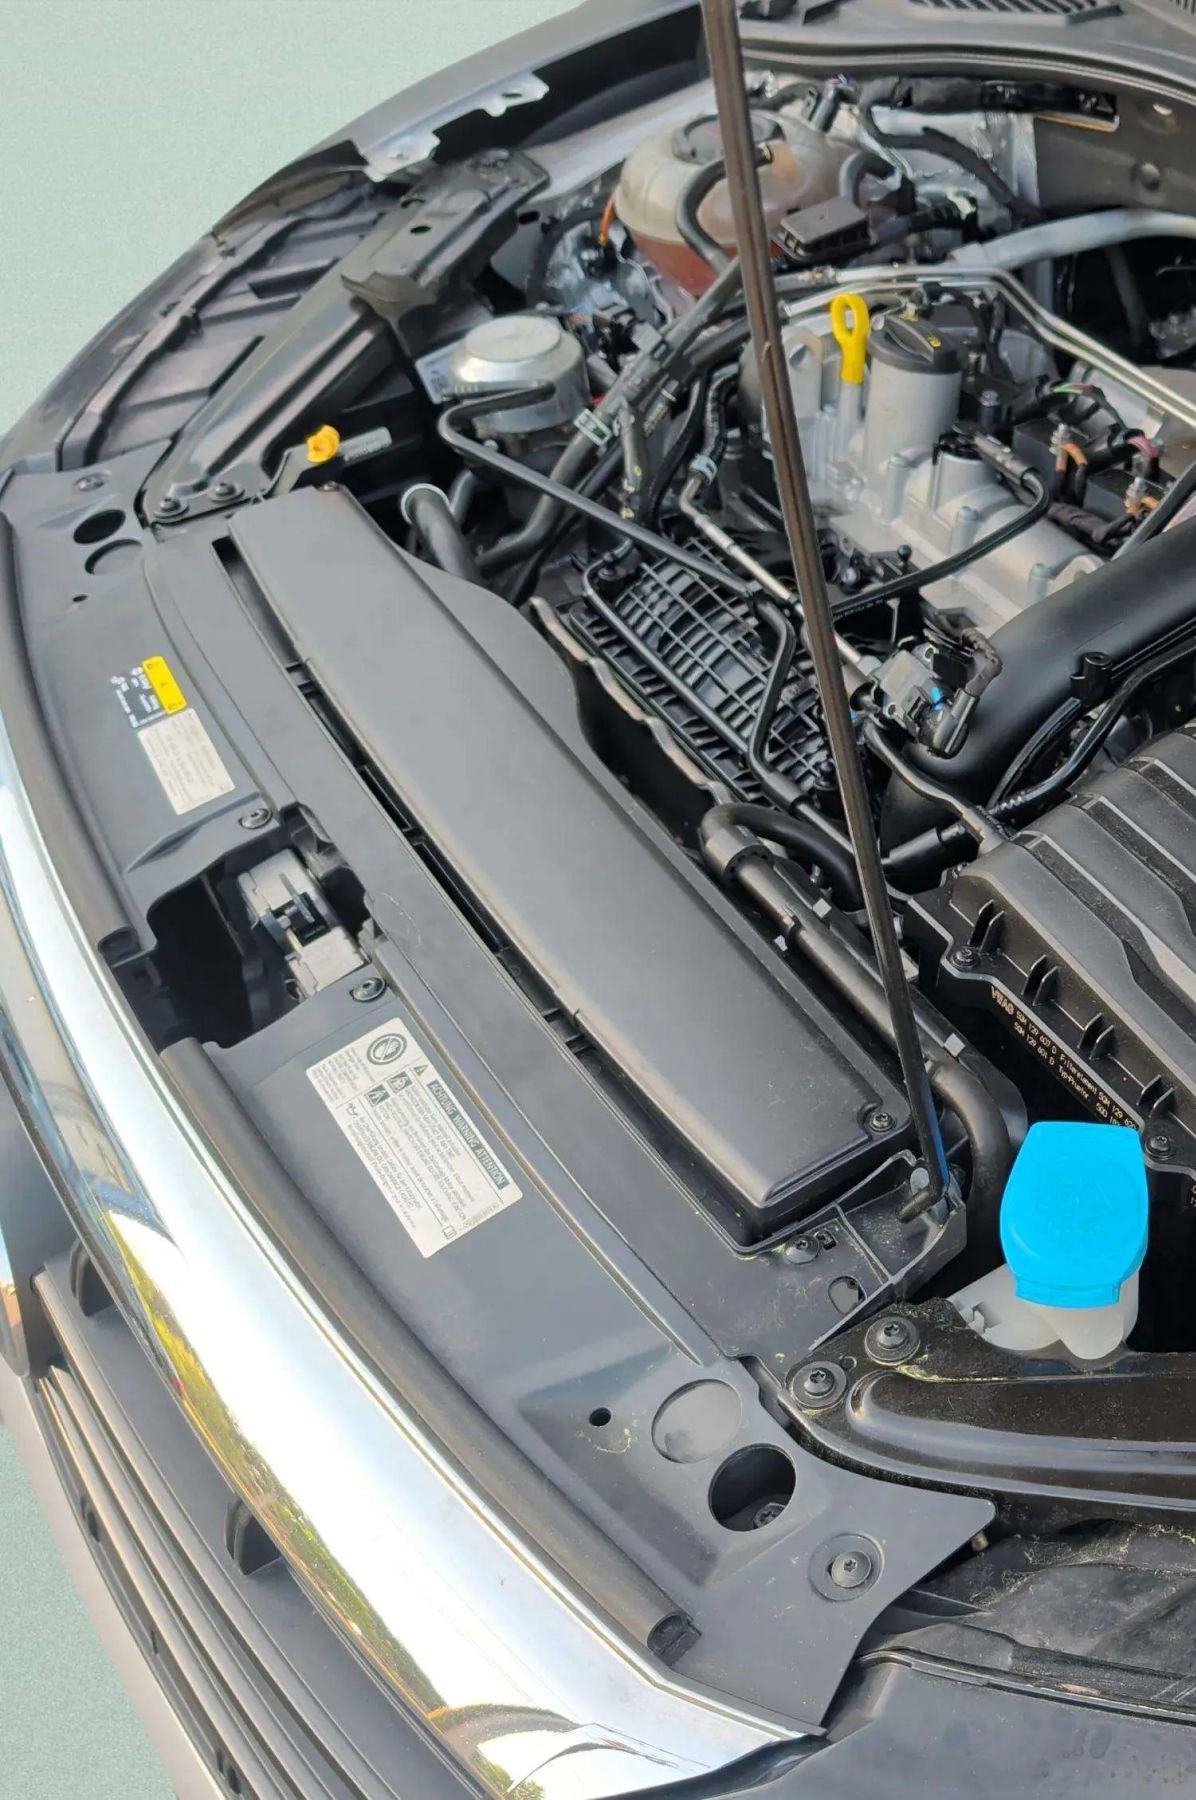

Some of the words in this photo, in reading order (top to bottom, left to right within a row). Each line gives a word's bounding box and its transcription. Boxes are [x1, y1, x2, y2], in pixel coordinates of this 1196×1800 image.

[1026, 1034, 1037, 1047] 129
[1028, 1022, 1039, 1036] 129
[1112, 1105, 1123, 1119] 129
[429, 1081, 458, 1115] ACHTUNG
[451, 1113, 481, 1148] WARNING
[474, 1145, 507, 1186] ATTENTION
